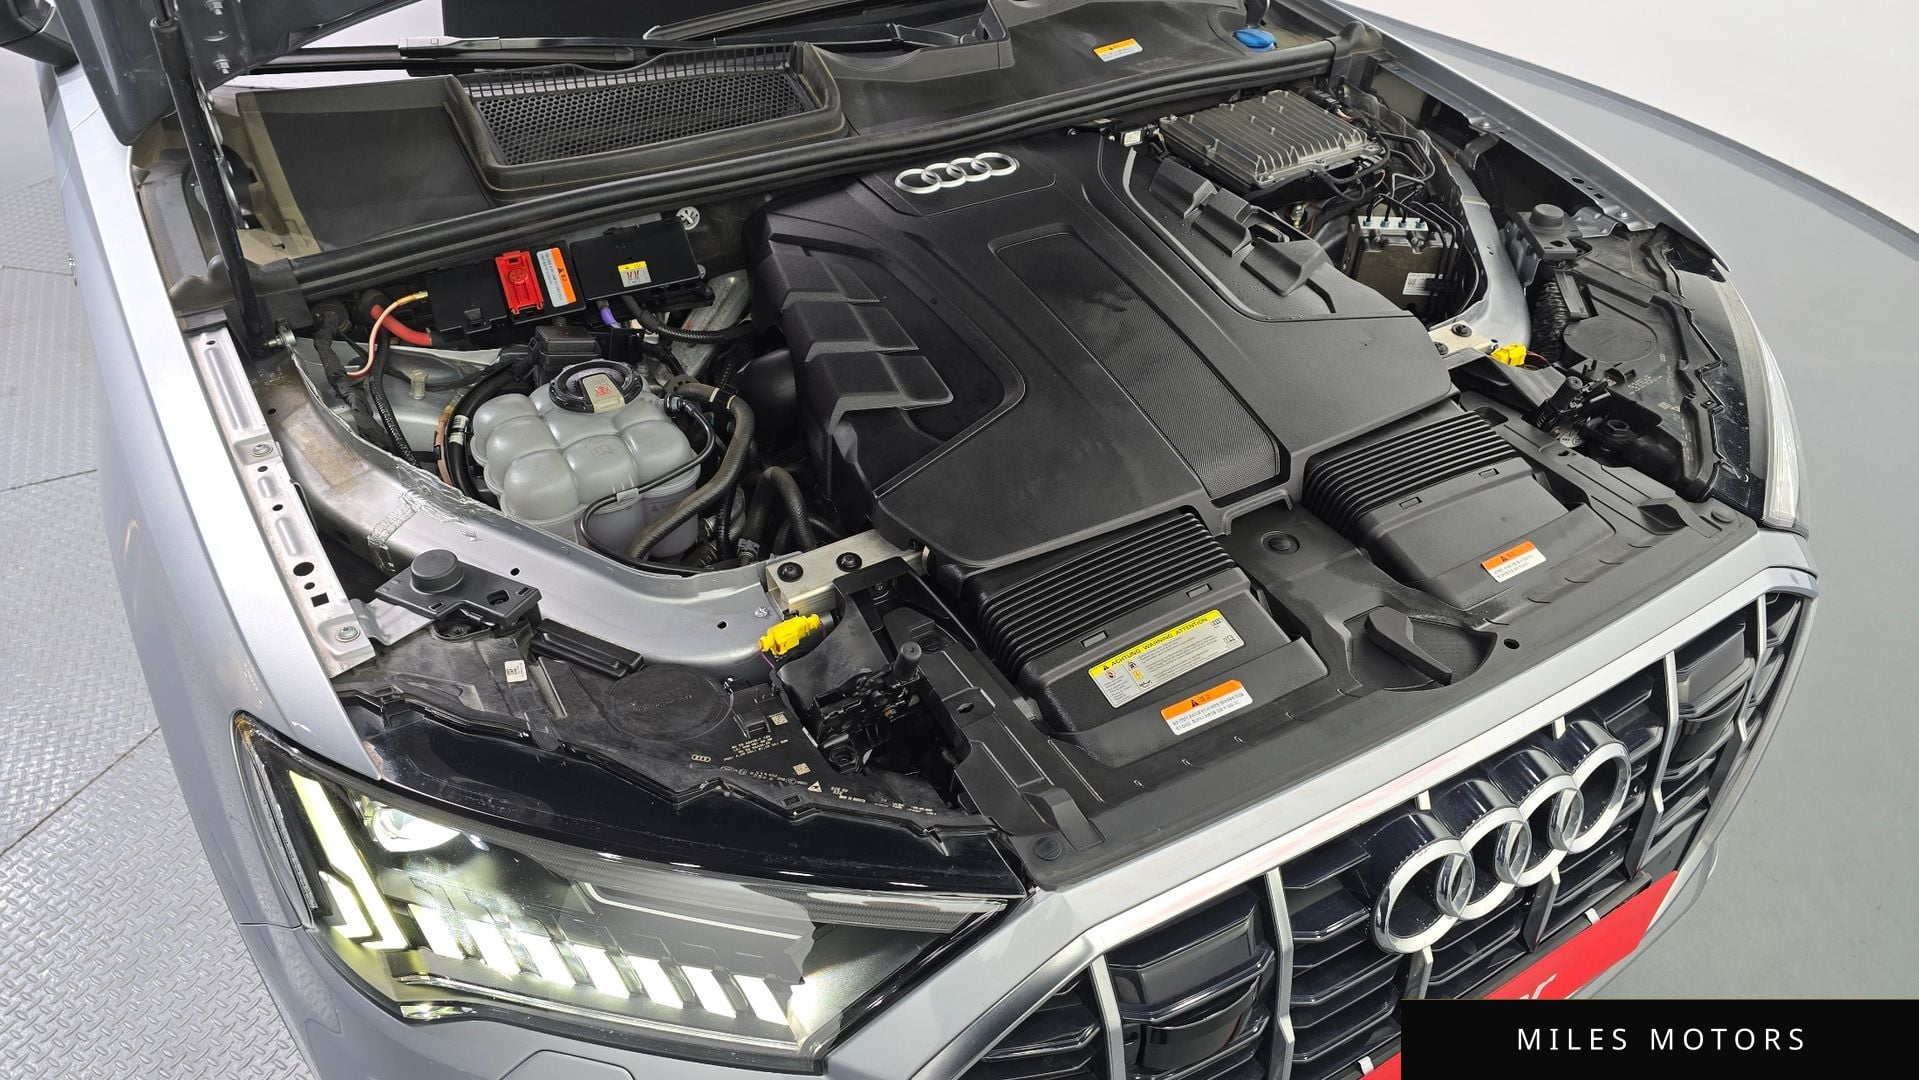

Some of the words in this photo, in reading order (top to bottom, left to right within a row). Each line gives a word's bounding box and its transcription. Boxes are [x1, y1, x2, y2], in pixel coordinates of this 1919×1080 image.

[1111, 649, 1141, 666] ACHTUNG
[1143, 634, 1174, 650] WARNING
[1175, 618, 1208, 635] ATTENTION
